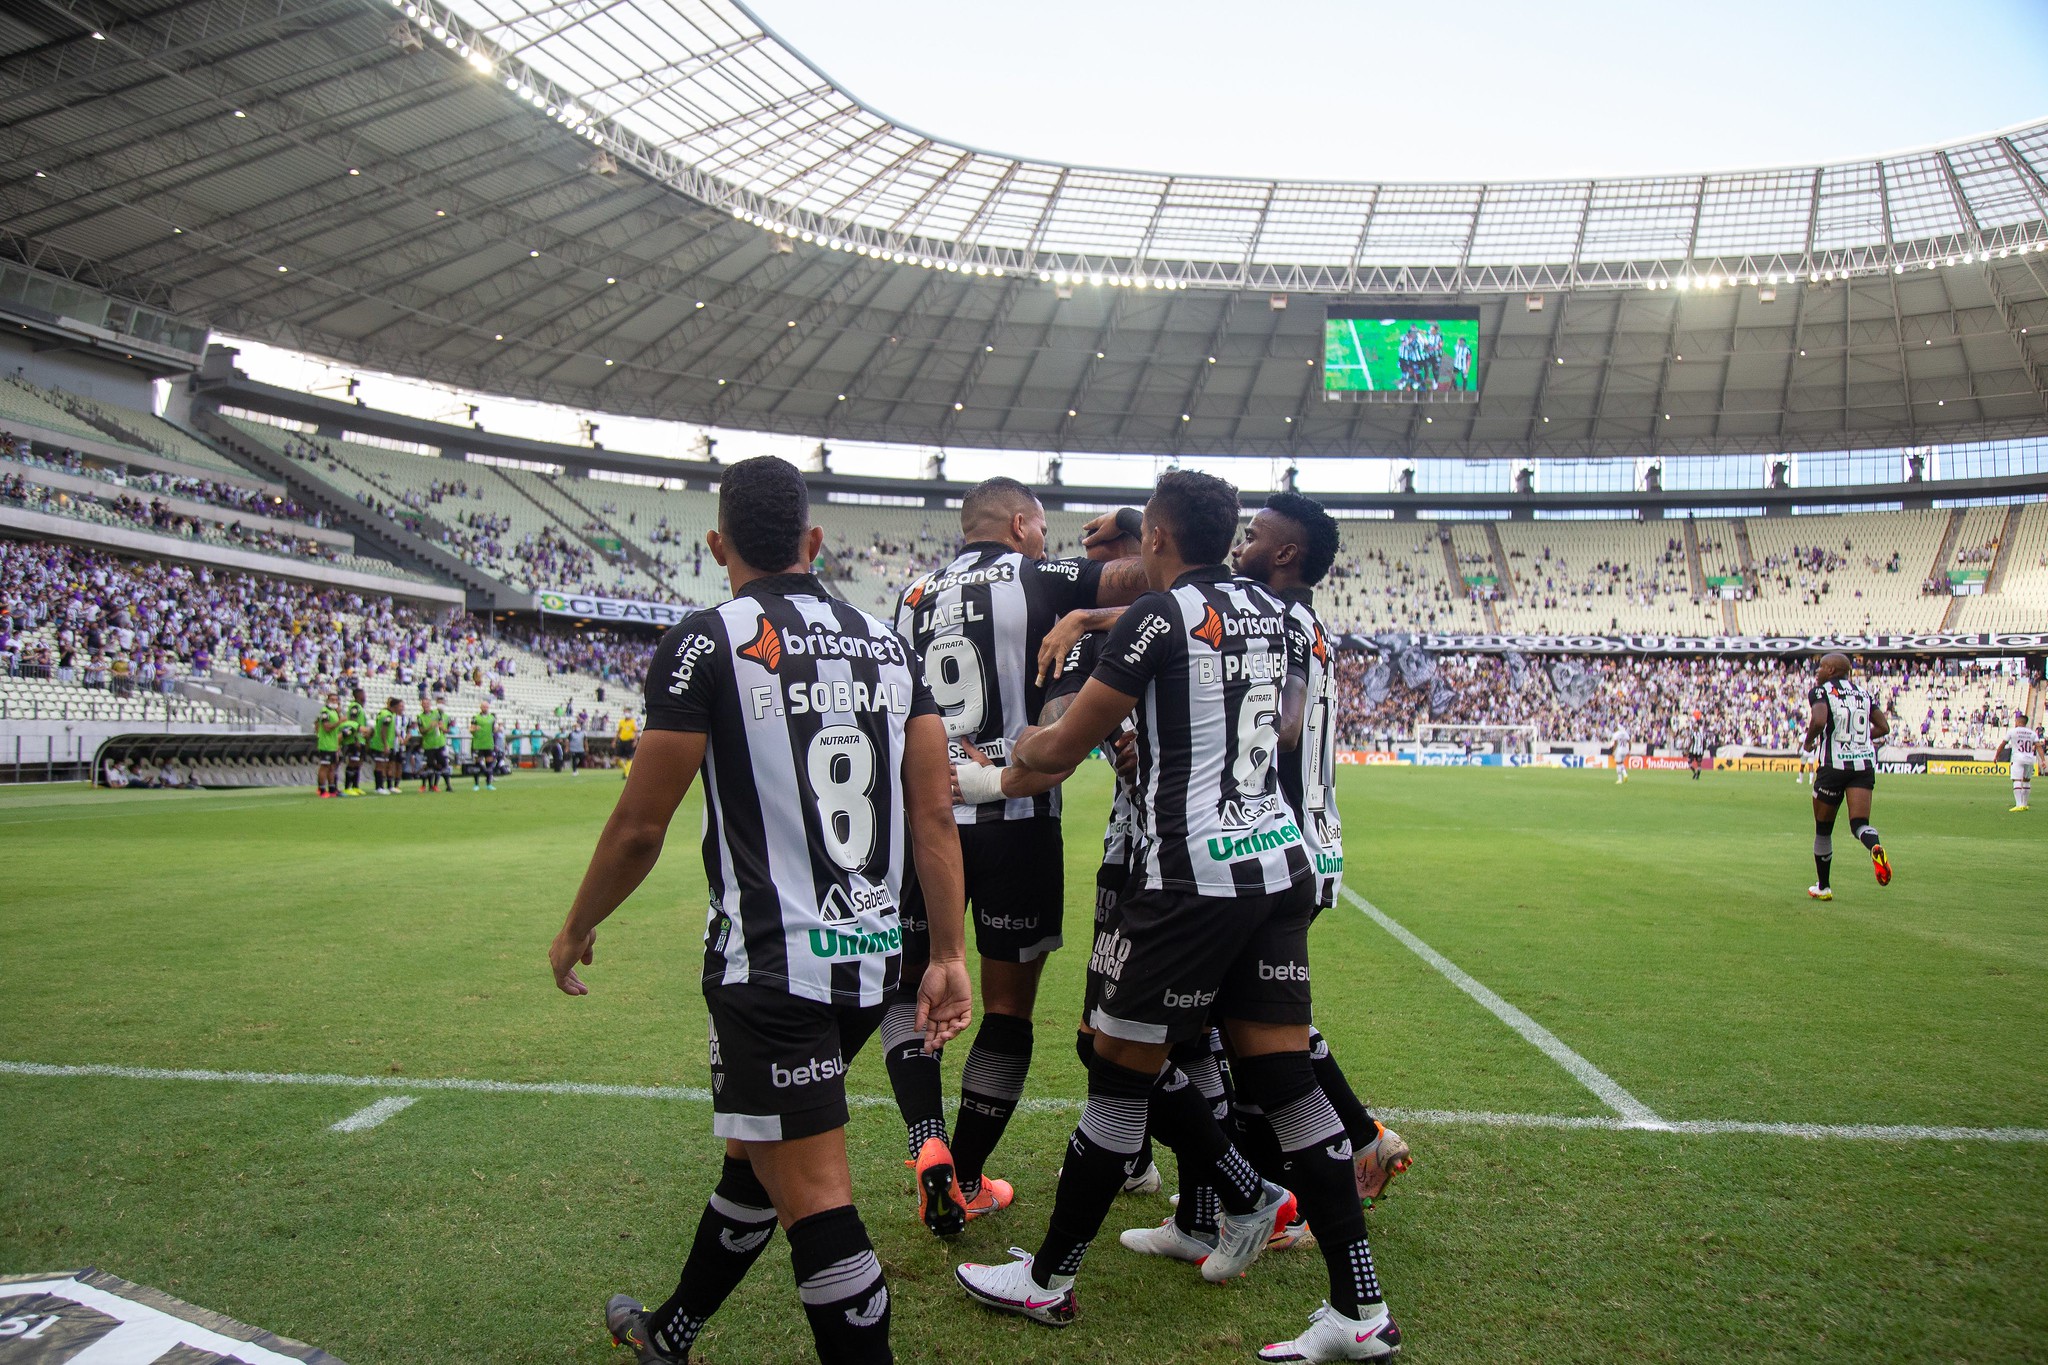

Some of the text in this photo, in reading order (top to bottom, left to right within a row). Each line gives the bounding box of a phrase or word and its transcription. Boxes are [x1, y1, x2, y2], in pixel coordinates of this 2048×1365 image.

[924, 563, 1014, 596] brisanet
[1047, 563, 1080, 582] bmg
[919, 601, 984, 634] JAEL
[1222, 611, 1284, 636] brisan
[781, 626, 906, 663] brisanet
[932, 640, 964, 652] NUTRATA
[1131, 615, 1172, 655] bmg
[671, 634, 716, 681] bmg
[1198, 656, 1223, 684] B.
[925, 634, 990, 738] 9
[1247, 693, 1272, 703] NUTRATA
[751, 682, 907, 720] F. SOBRAL
[1834, 707, 1868, 745] 19
[819, 734, 860, 746] NUTRATA
[950, 741, 1003, 759] Saemi
[1232, 684, 1279, 800] 6
[2017, 740, 2032, 753] 30
[1738, 759, 1799, 772] betfair
[1950, 765, 2007, 774] mercado
[807, 725, 877, 875] 8
[1207, 819, 1301, 861] Unimed
[1328, 824, 1341, 840] Sab
[901, 915, 928, 932] ets
[981, 908, 1039, 930] betsu
[1258, 959, 1310, 981] betsu
[771, 1048, 844, 1088] betsu
[963, 1097, 1007, 1118] CSC
